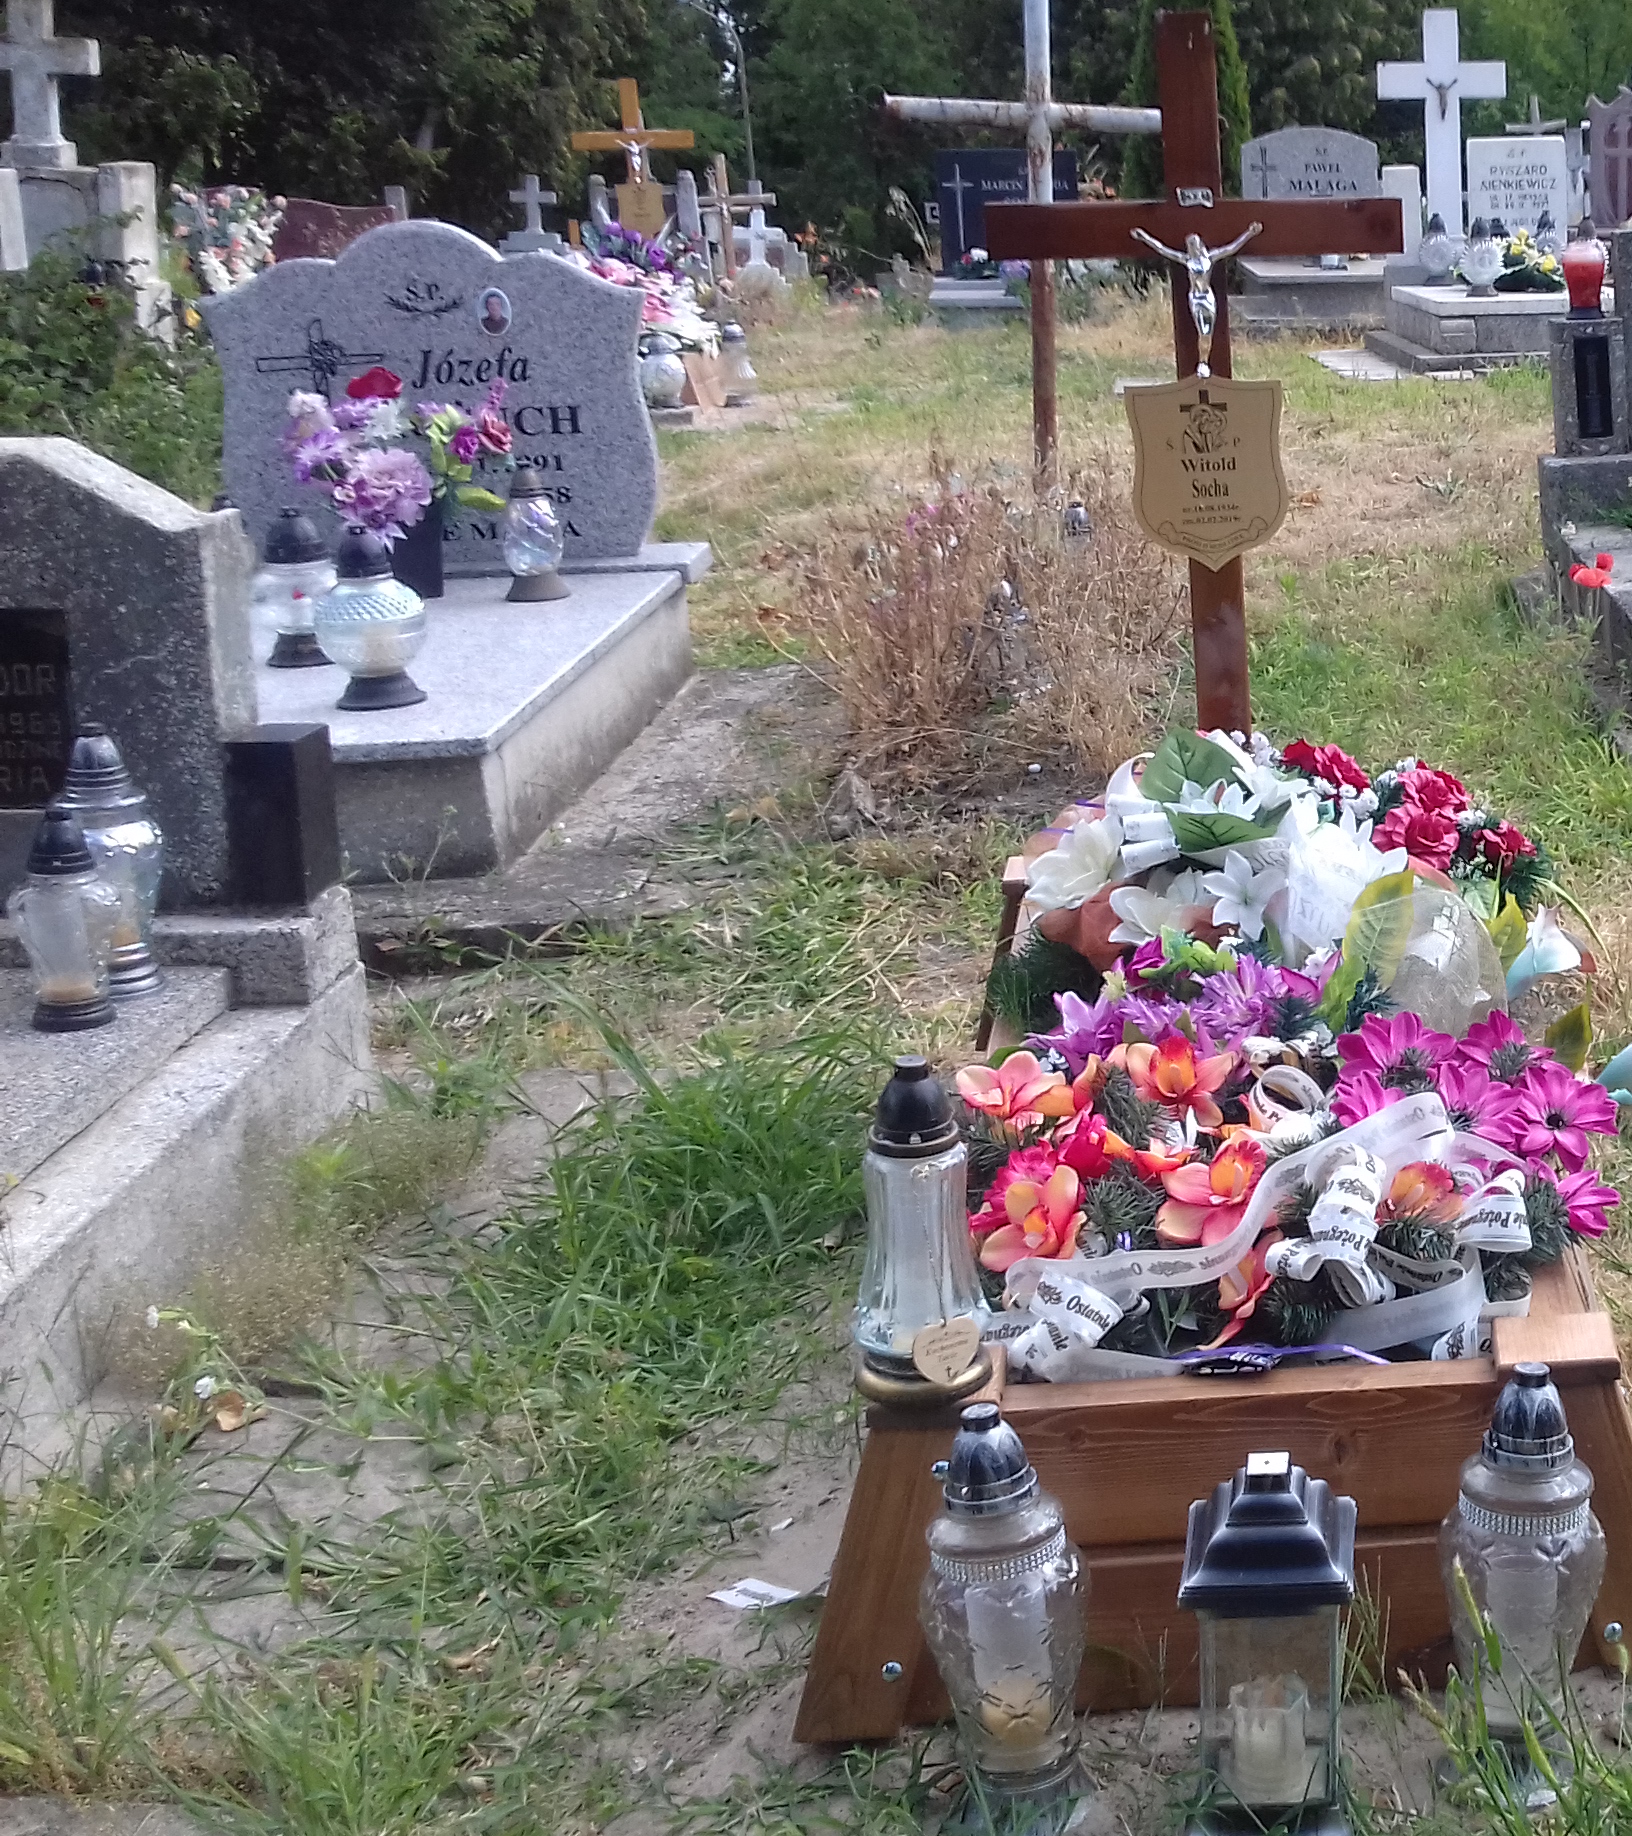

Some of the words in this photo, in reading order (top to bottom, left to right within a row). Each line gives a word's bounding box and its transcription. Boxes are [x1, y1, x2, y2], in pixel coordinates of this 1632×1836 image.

[411, 346, 530, 389] Józefa
[1180, 457, 1237, 473] Witold
[1192, 478, 1229, 498] Socha
[1066, 1295, 1111, 1332] Ostatnie
